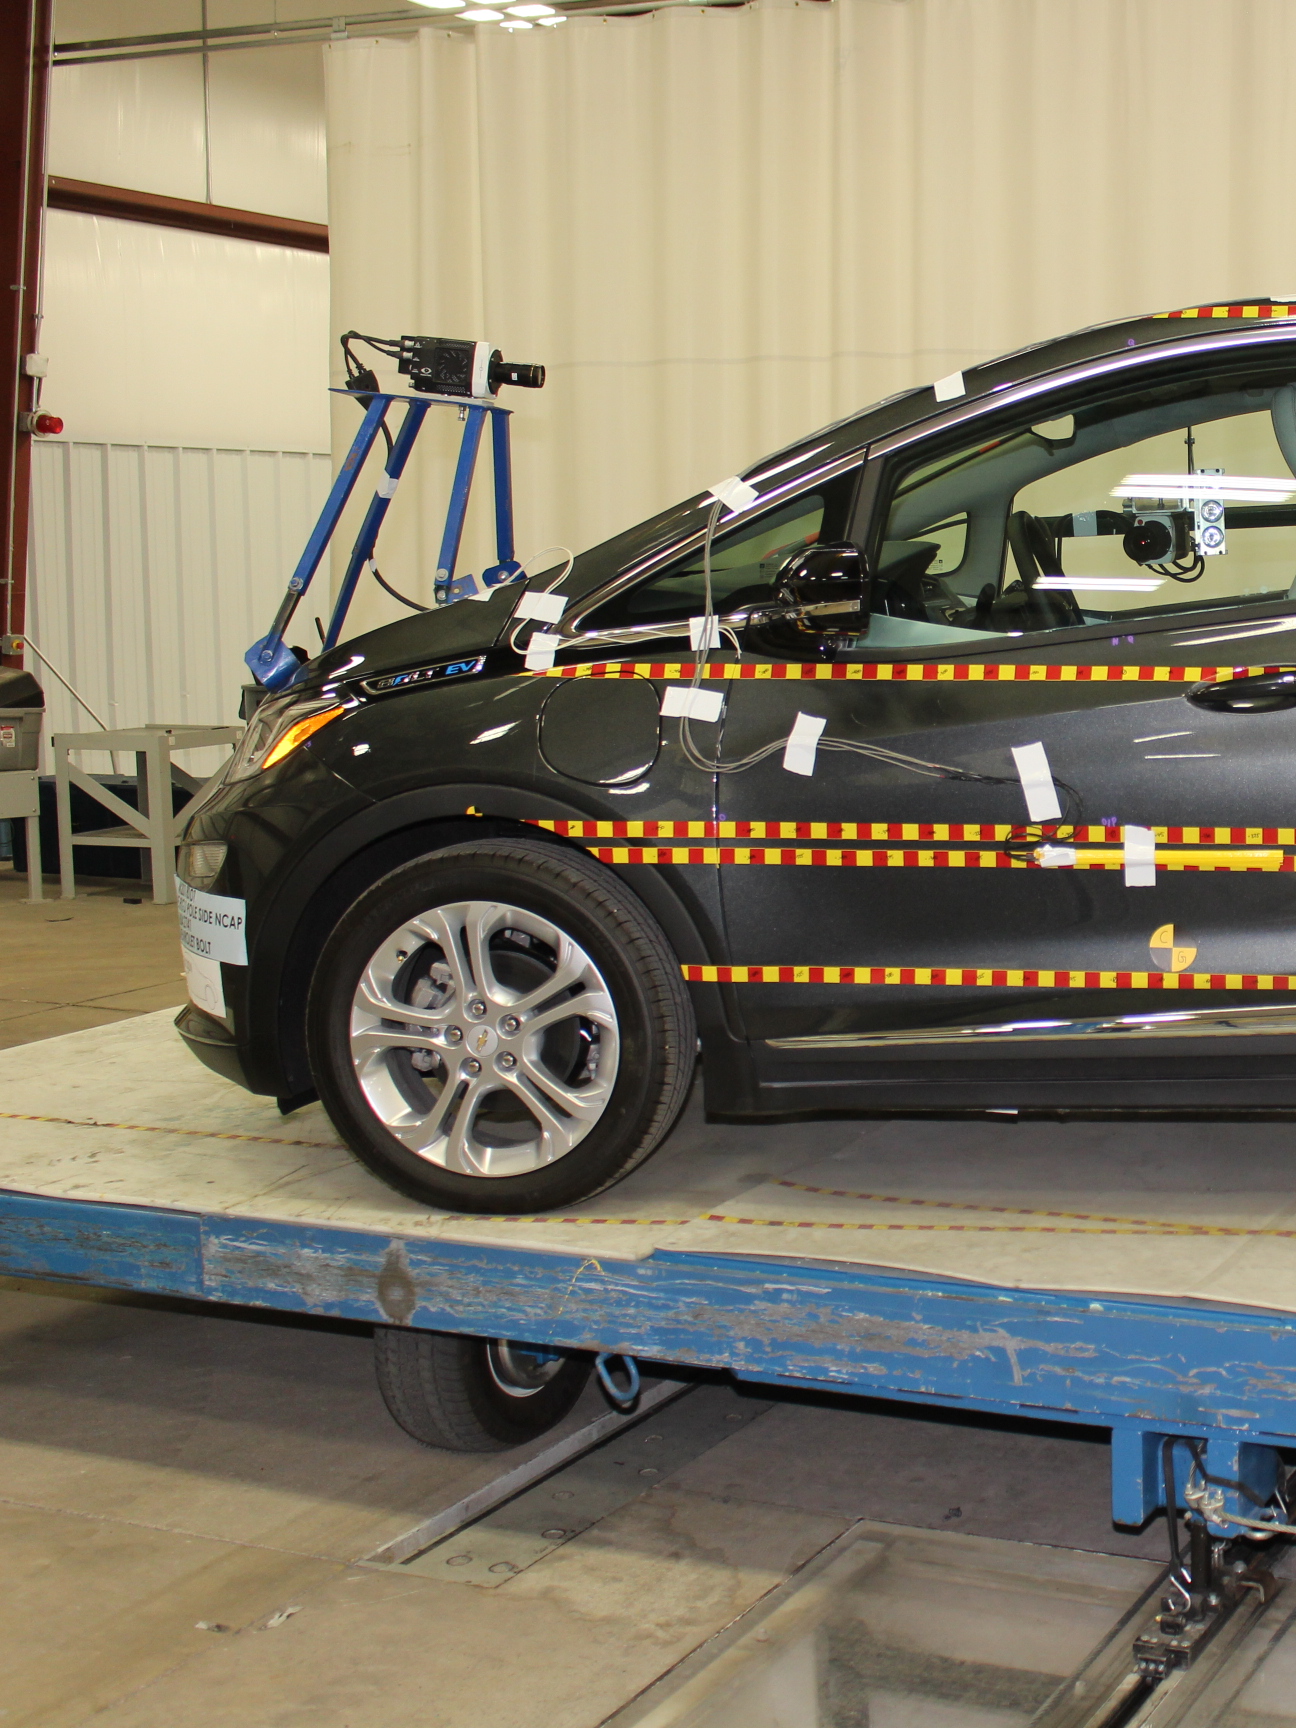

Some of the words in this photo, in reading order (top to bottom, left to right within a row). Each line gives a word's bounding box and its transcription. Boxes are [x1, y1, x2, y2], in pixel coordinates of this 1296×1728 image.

[445, 660, 477, 676] EV
[198, 907, 213, 925] SIDE
[215, 912, 243, 931] NCAP
[195, 937, 211, 955] BOLT
